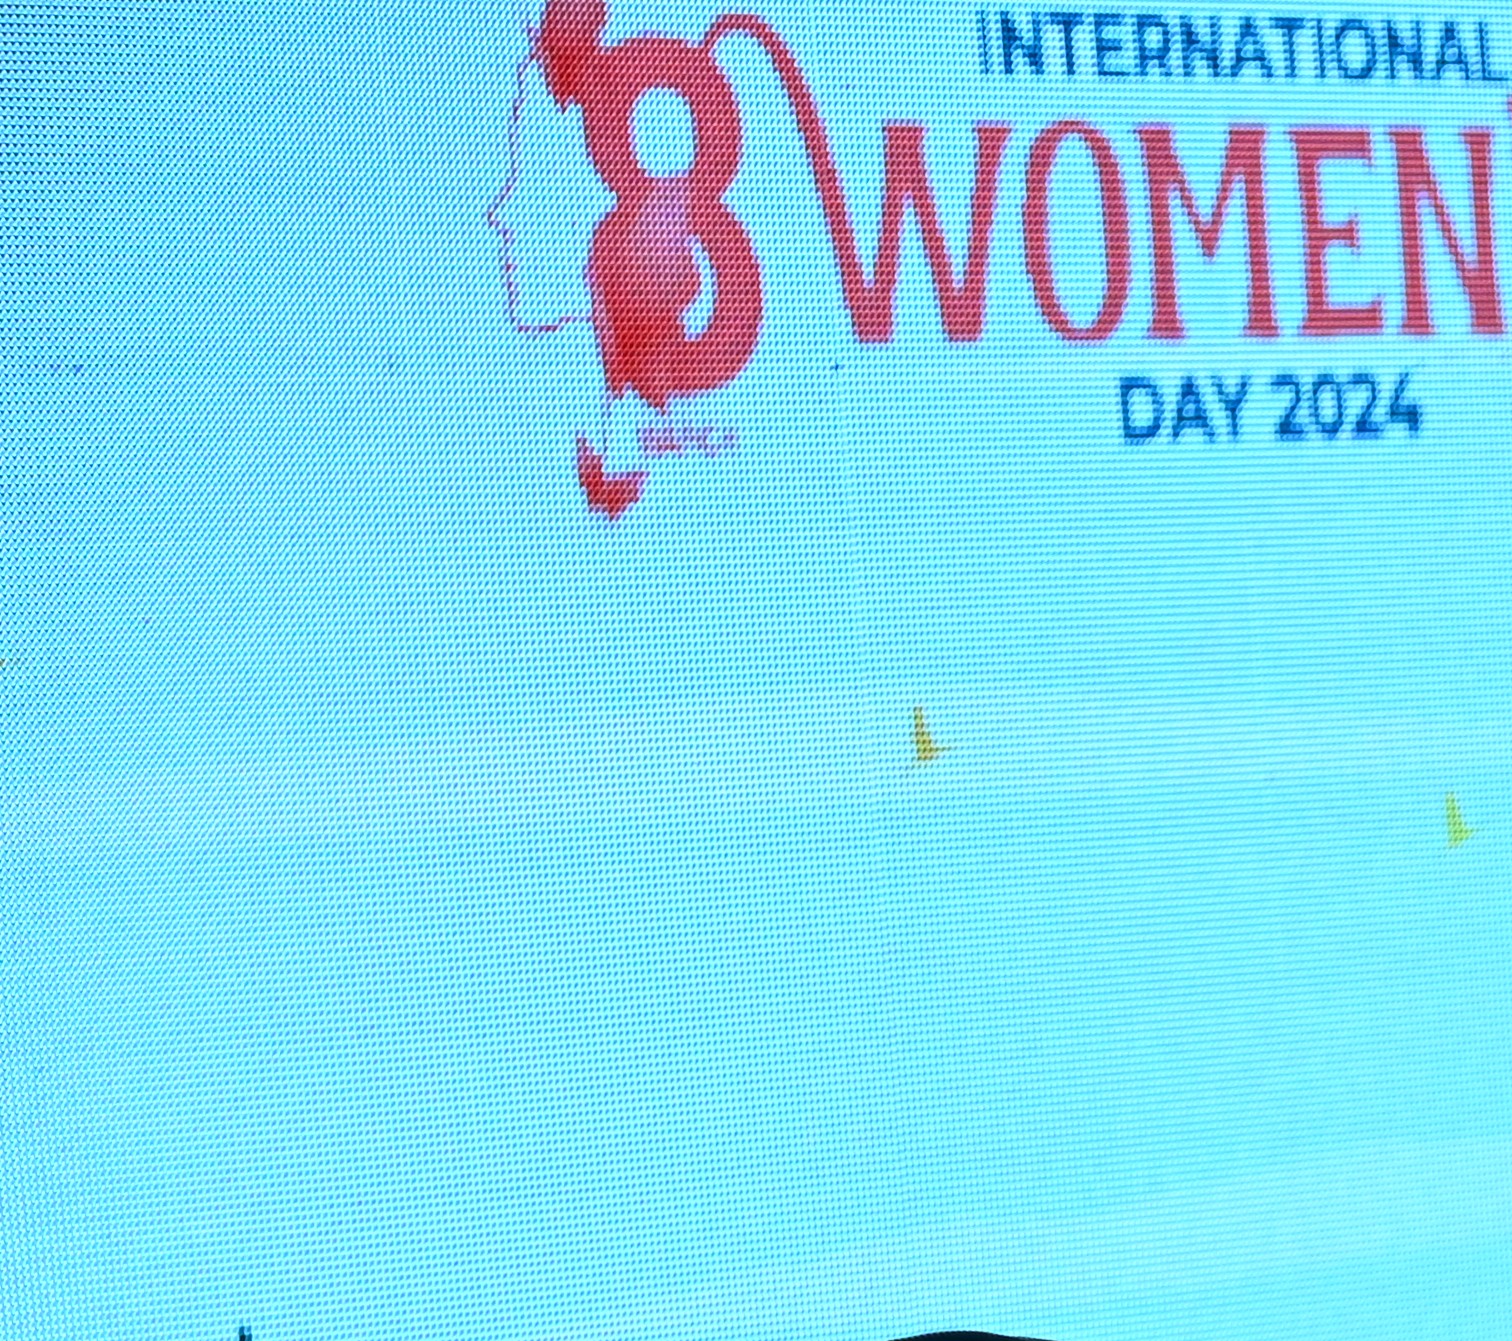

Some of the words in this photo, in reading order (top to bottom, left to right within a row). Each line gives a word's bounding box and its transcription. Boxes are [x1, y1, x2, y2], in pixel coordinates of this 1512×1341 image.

[974, 9, 1511, 83] INTERNATIONAL
[1117, 373, 1252, 444] DAY
[1270, 369, 1424, 442] 2024
